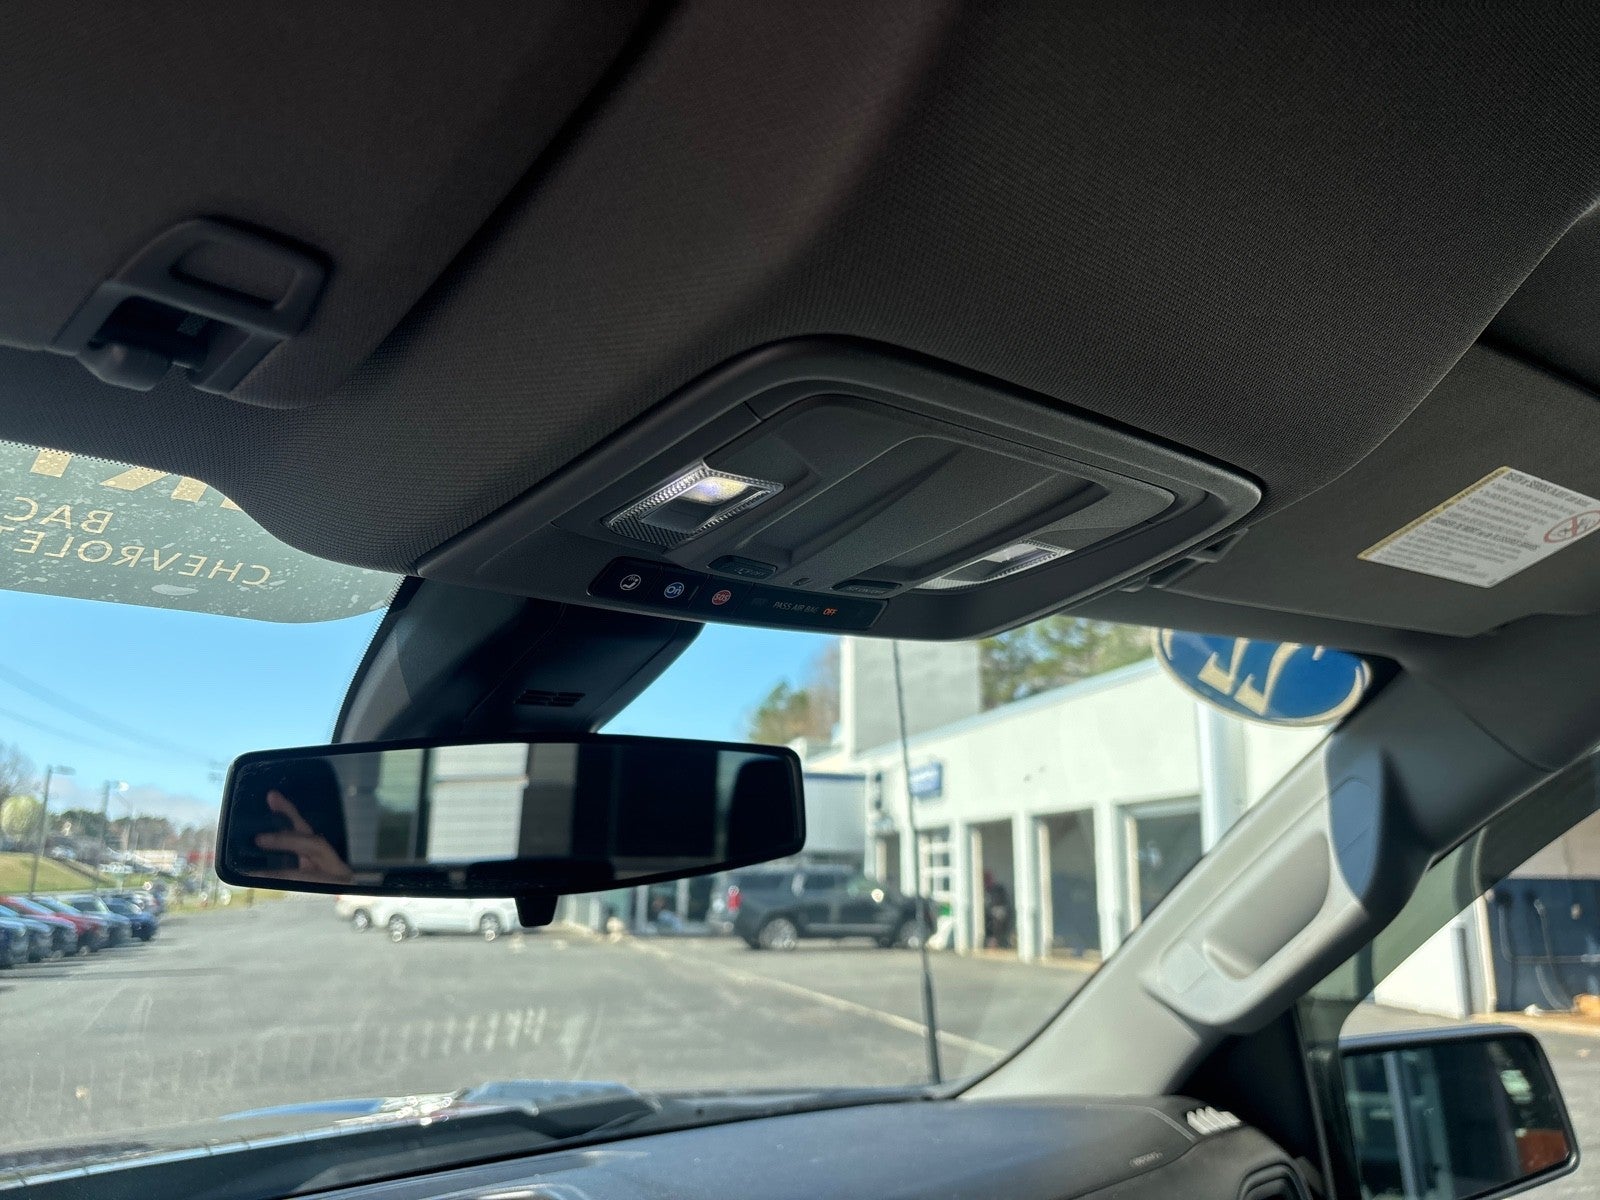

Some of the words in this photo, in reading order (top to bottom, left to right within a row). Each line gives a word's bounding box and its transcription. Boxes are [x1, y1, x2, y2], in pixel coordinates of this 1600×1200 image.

[713, 591, 730, 602] SOS
[773, 601, 792, 611] PASS
[791, 603, 805, 612] AIR
[822, 607, 838, 616] OFF
